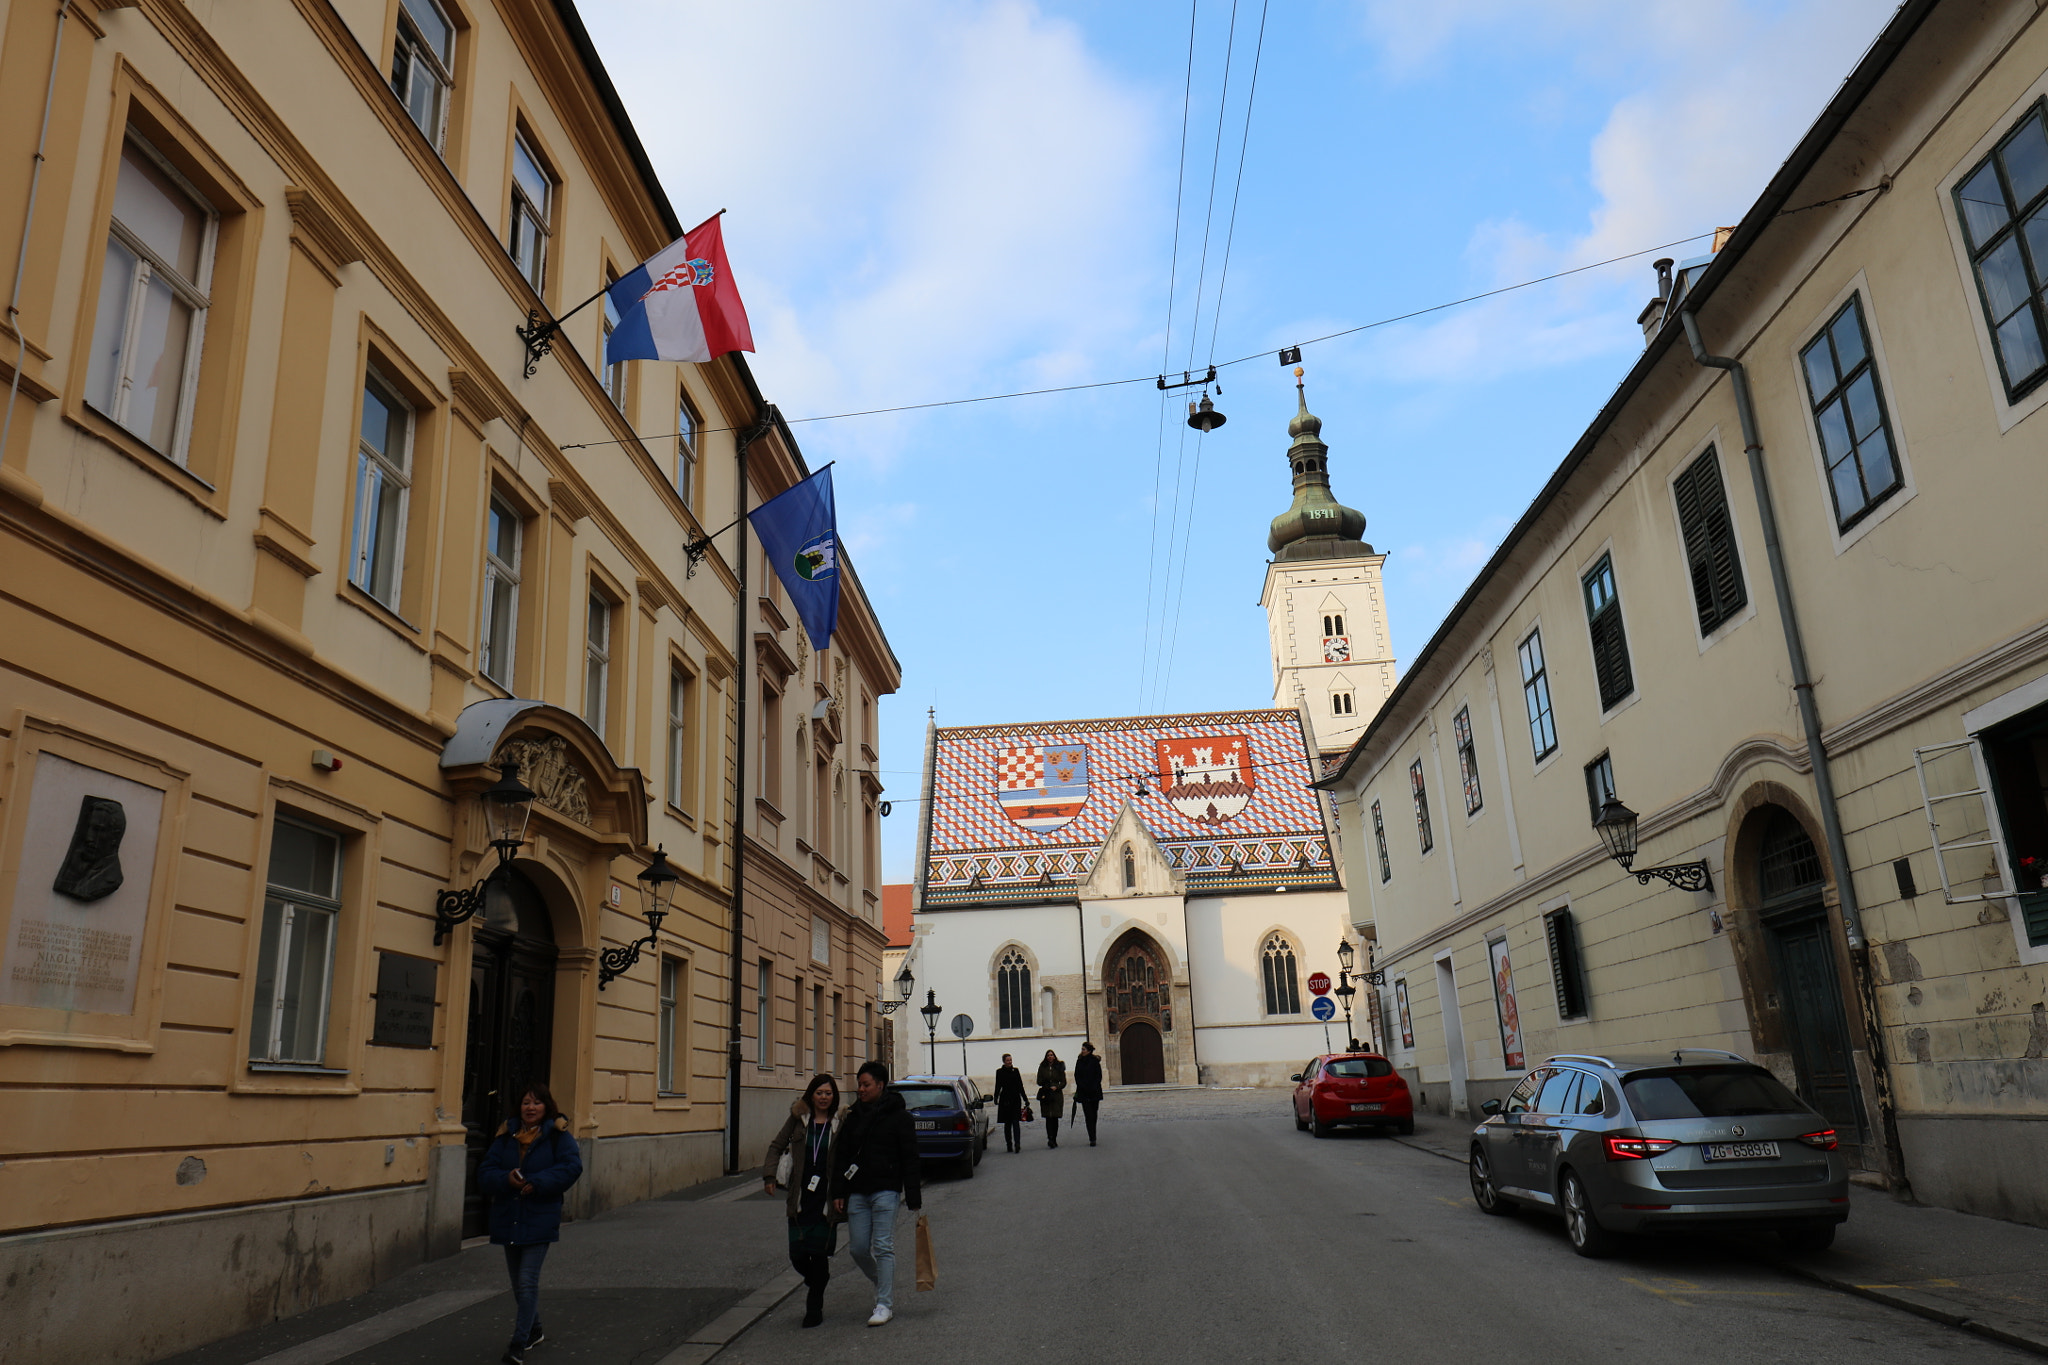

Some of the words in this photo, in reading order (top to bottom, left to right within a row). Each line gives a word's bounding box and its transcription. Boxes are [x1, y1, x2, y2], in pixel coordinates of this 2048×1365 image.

[1309, 508, 1335, 520] 1841
[37, 951, 76, 965] NIKOLA
[81, 956, 110, 969] TESLA
[1309, 978, 1330, 989] STOP
[1711, 1145, 1728, 1160] ZG
